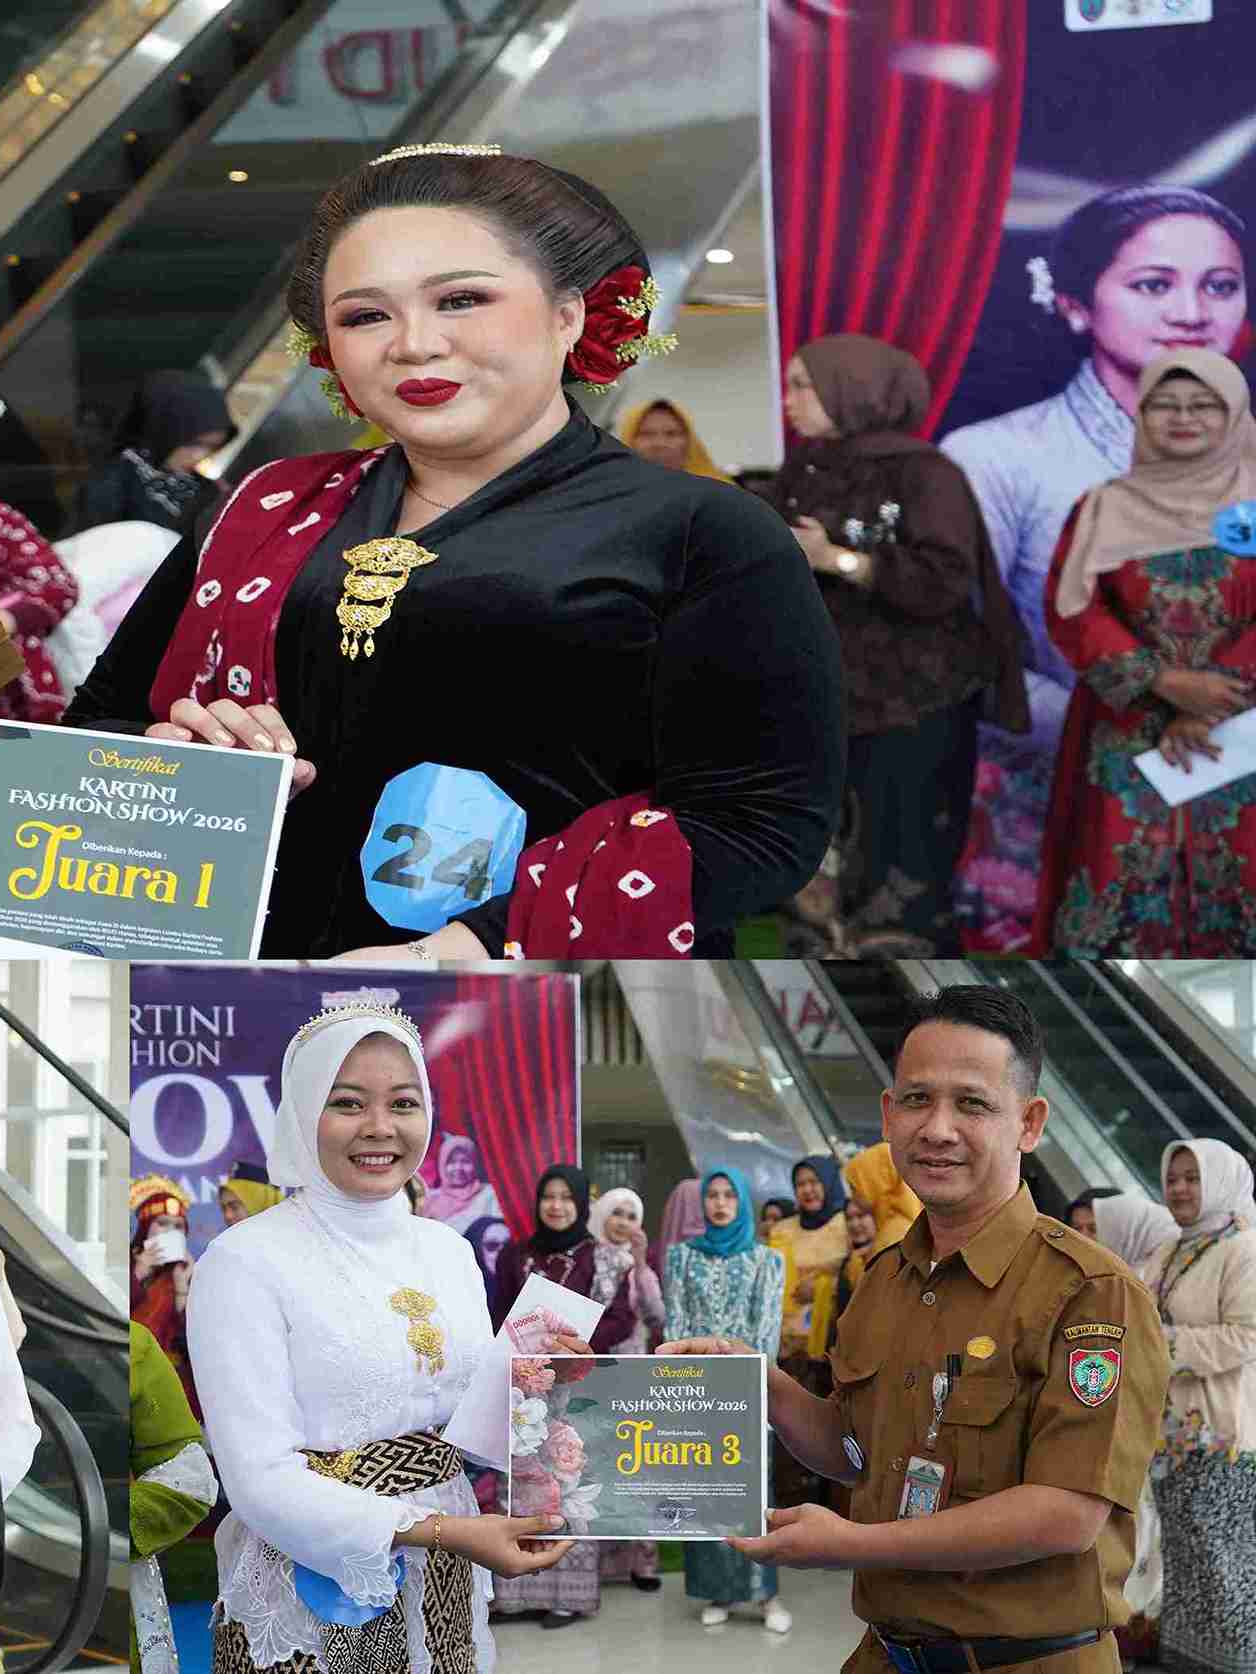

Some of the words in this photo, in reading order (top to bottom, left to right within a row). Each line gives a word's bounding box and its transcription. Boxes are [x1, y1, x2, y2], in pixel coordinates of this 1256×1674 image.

[88, 748, 183, 777] Sertifikat
[79, 776, 177, 804] KARTINI
[8, 788, 115, 819] FASHION
[116, 801, 194, 826] SHOW
[193, 813, 248, 832] 2026
[81, 841, 126, 855] Diberikan
[370, 823, 494, 900] 24
[8, 820, 179, 903] Juara
[194, 862, 215, 908] 1
[611, 1399, 674, 1413] FASHION
[675, 1399, 716, 1413] SHOW
[717, 1400, 748, 1412] 2026
[649, 1385, 705, 1399] KARTINI
[616, 1419, 712, 1475] Juara
[722, 1434, 742, 1466] 3
